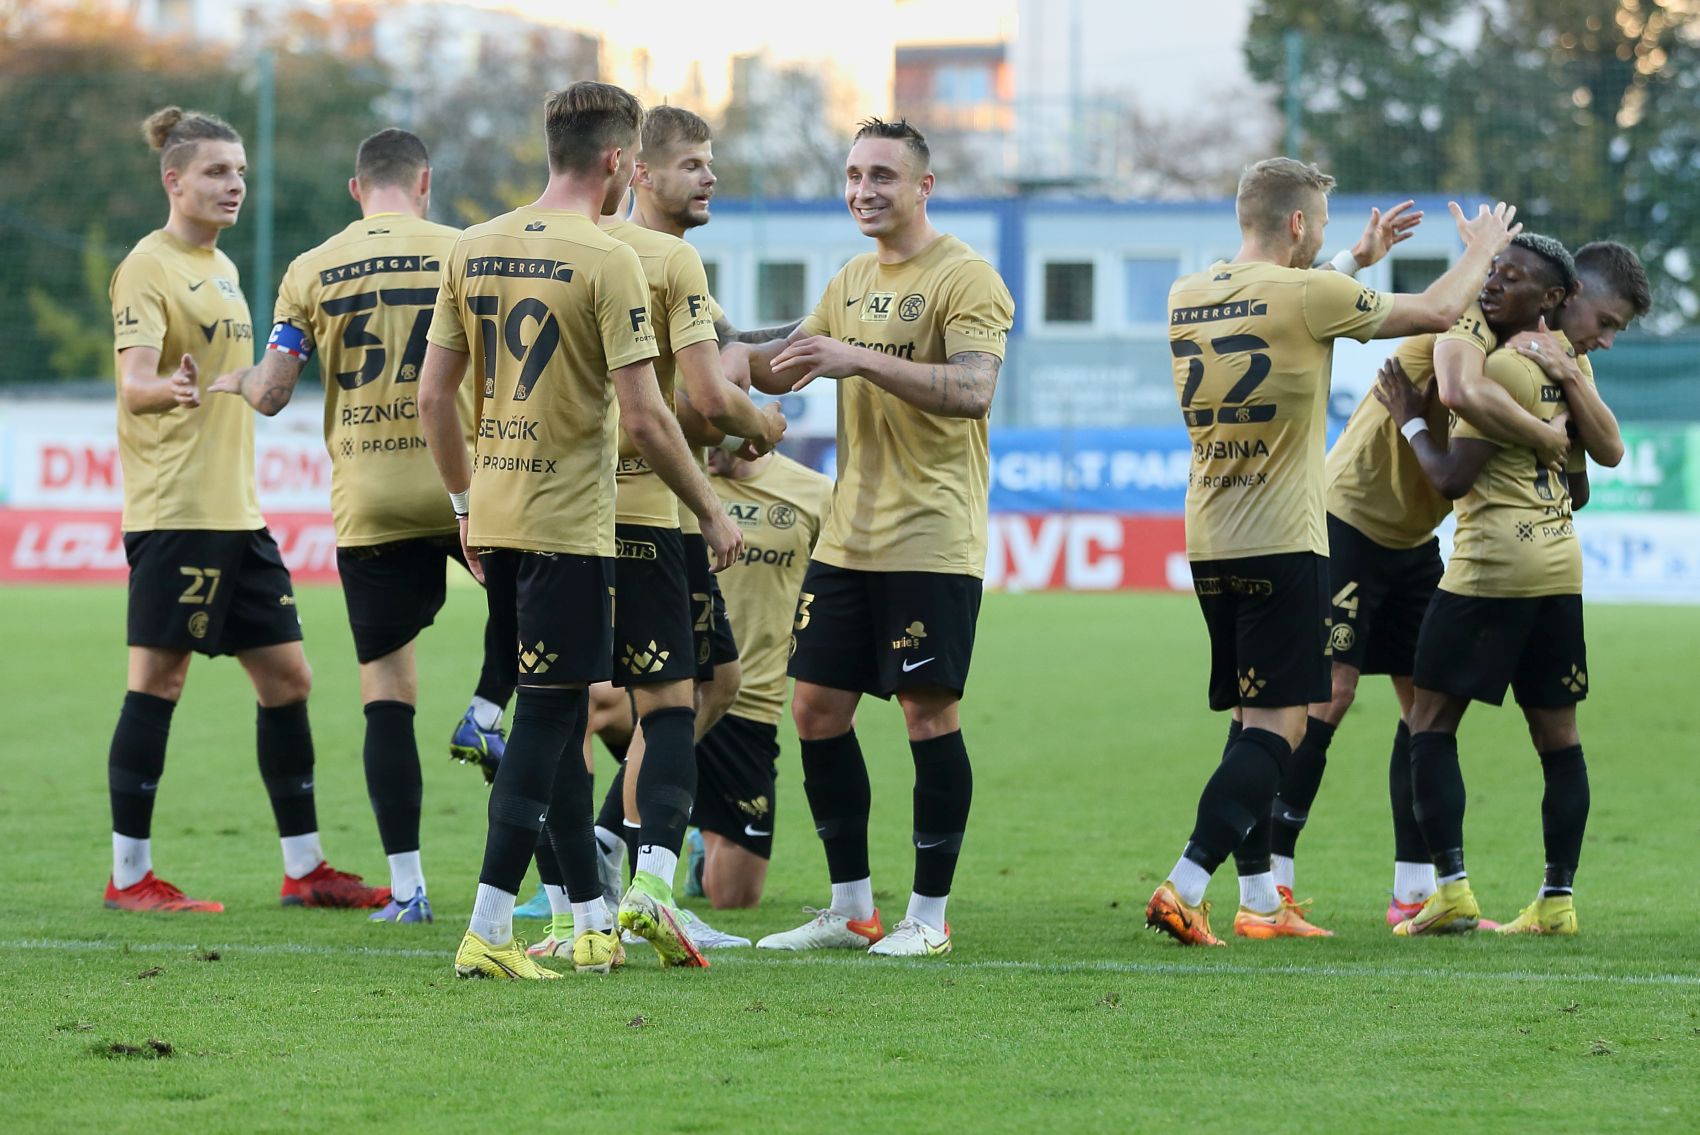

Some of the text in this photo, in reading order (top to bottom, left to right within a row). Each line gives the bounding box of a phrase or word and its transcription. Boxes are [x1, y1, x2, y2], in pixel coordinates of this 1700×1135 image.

[325, 260, 413, 282] SYNERGA
[471, 261, 546, 275] SYNERGA
[867, 296, 892, 313] AZ
[1172, 305, 1242, 322] SYNERGA
[320, 287, 440, 391] 37
[467, 295, 560, 401] 19
[1170, 334, 1277, 427] 22
[342, 396, 420, 426] ŘEZNÍČ
[483, 456, 557, 474] PROBINEX
[728, 505, 760, 520] AZ
[178, 566, 221, 605] 27
